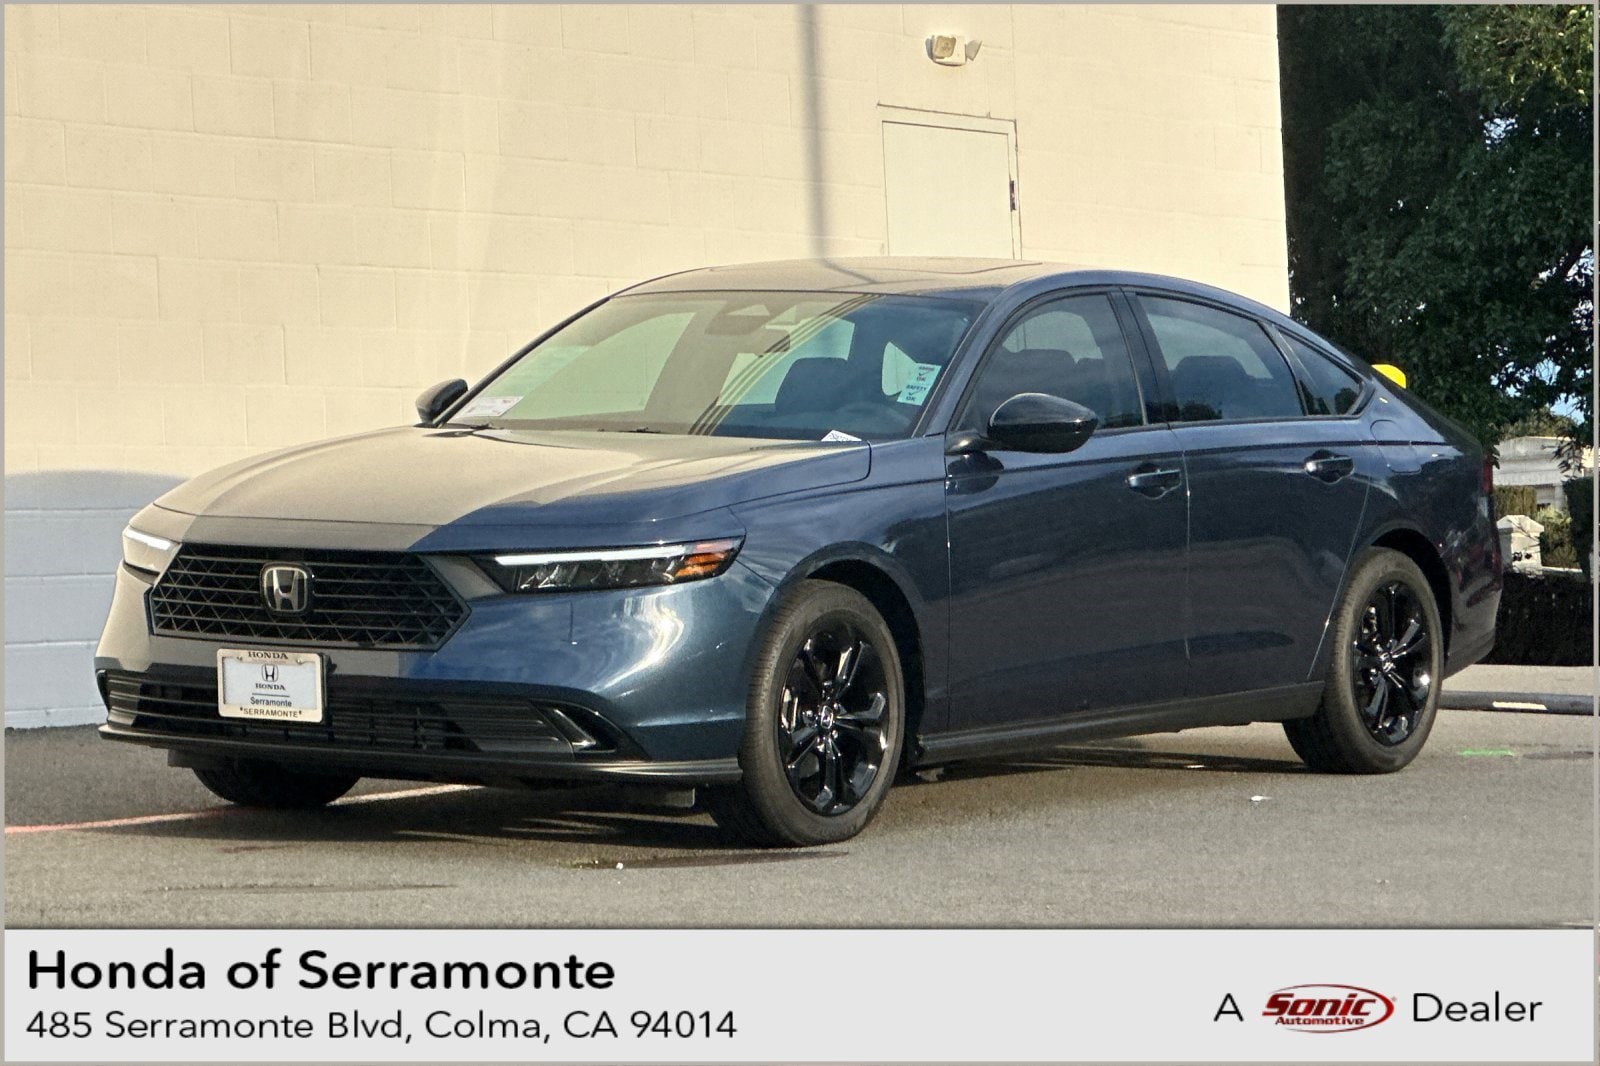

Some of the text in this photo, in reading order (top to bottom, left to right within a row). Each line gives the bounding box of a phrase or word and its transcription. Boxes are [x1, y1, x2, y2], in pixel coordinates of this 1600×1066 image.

[248, 651, 289, 660] HONDA
[255, 682, 286, 691] HONDA
[250, 696, 292, 708] Serramonte
